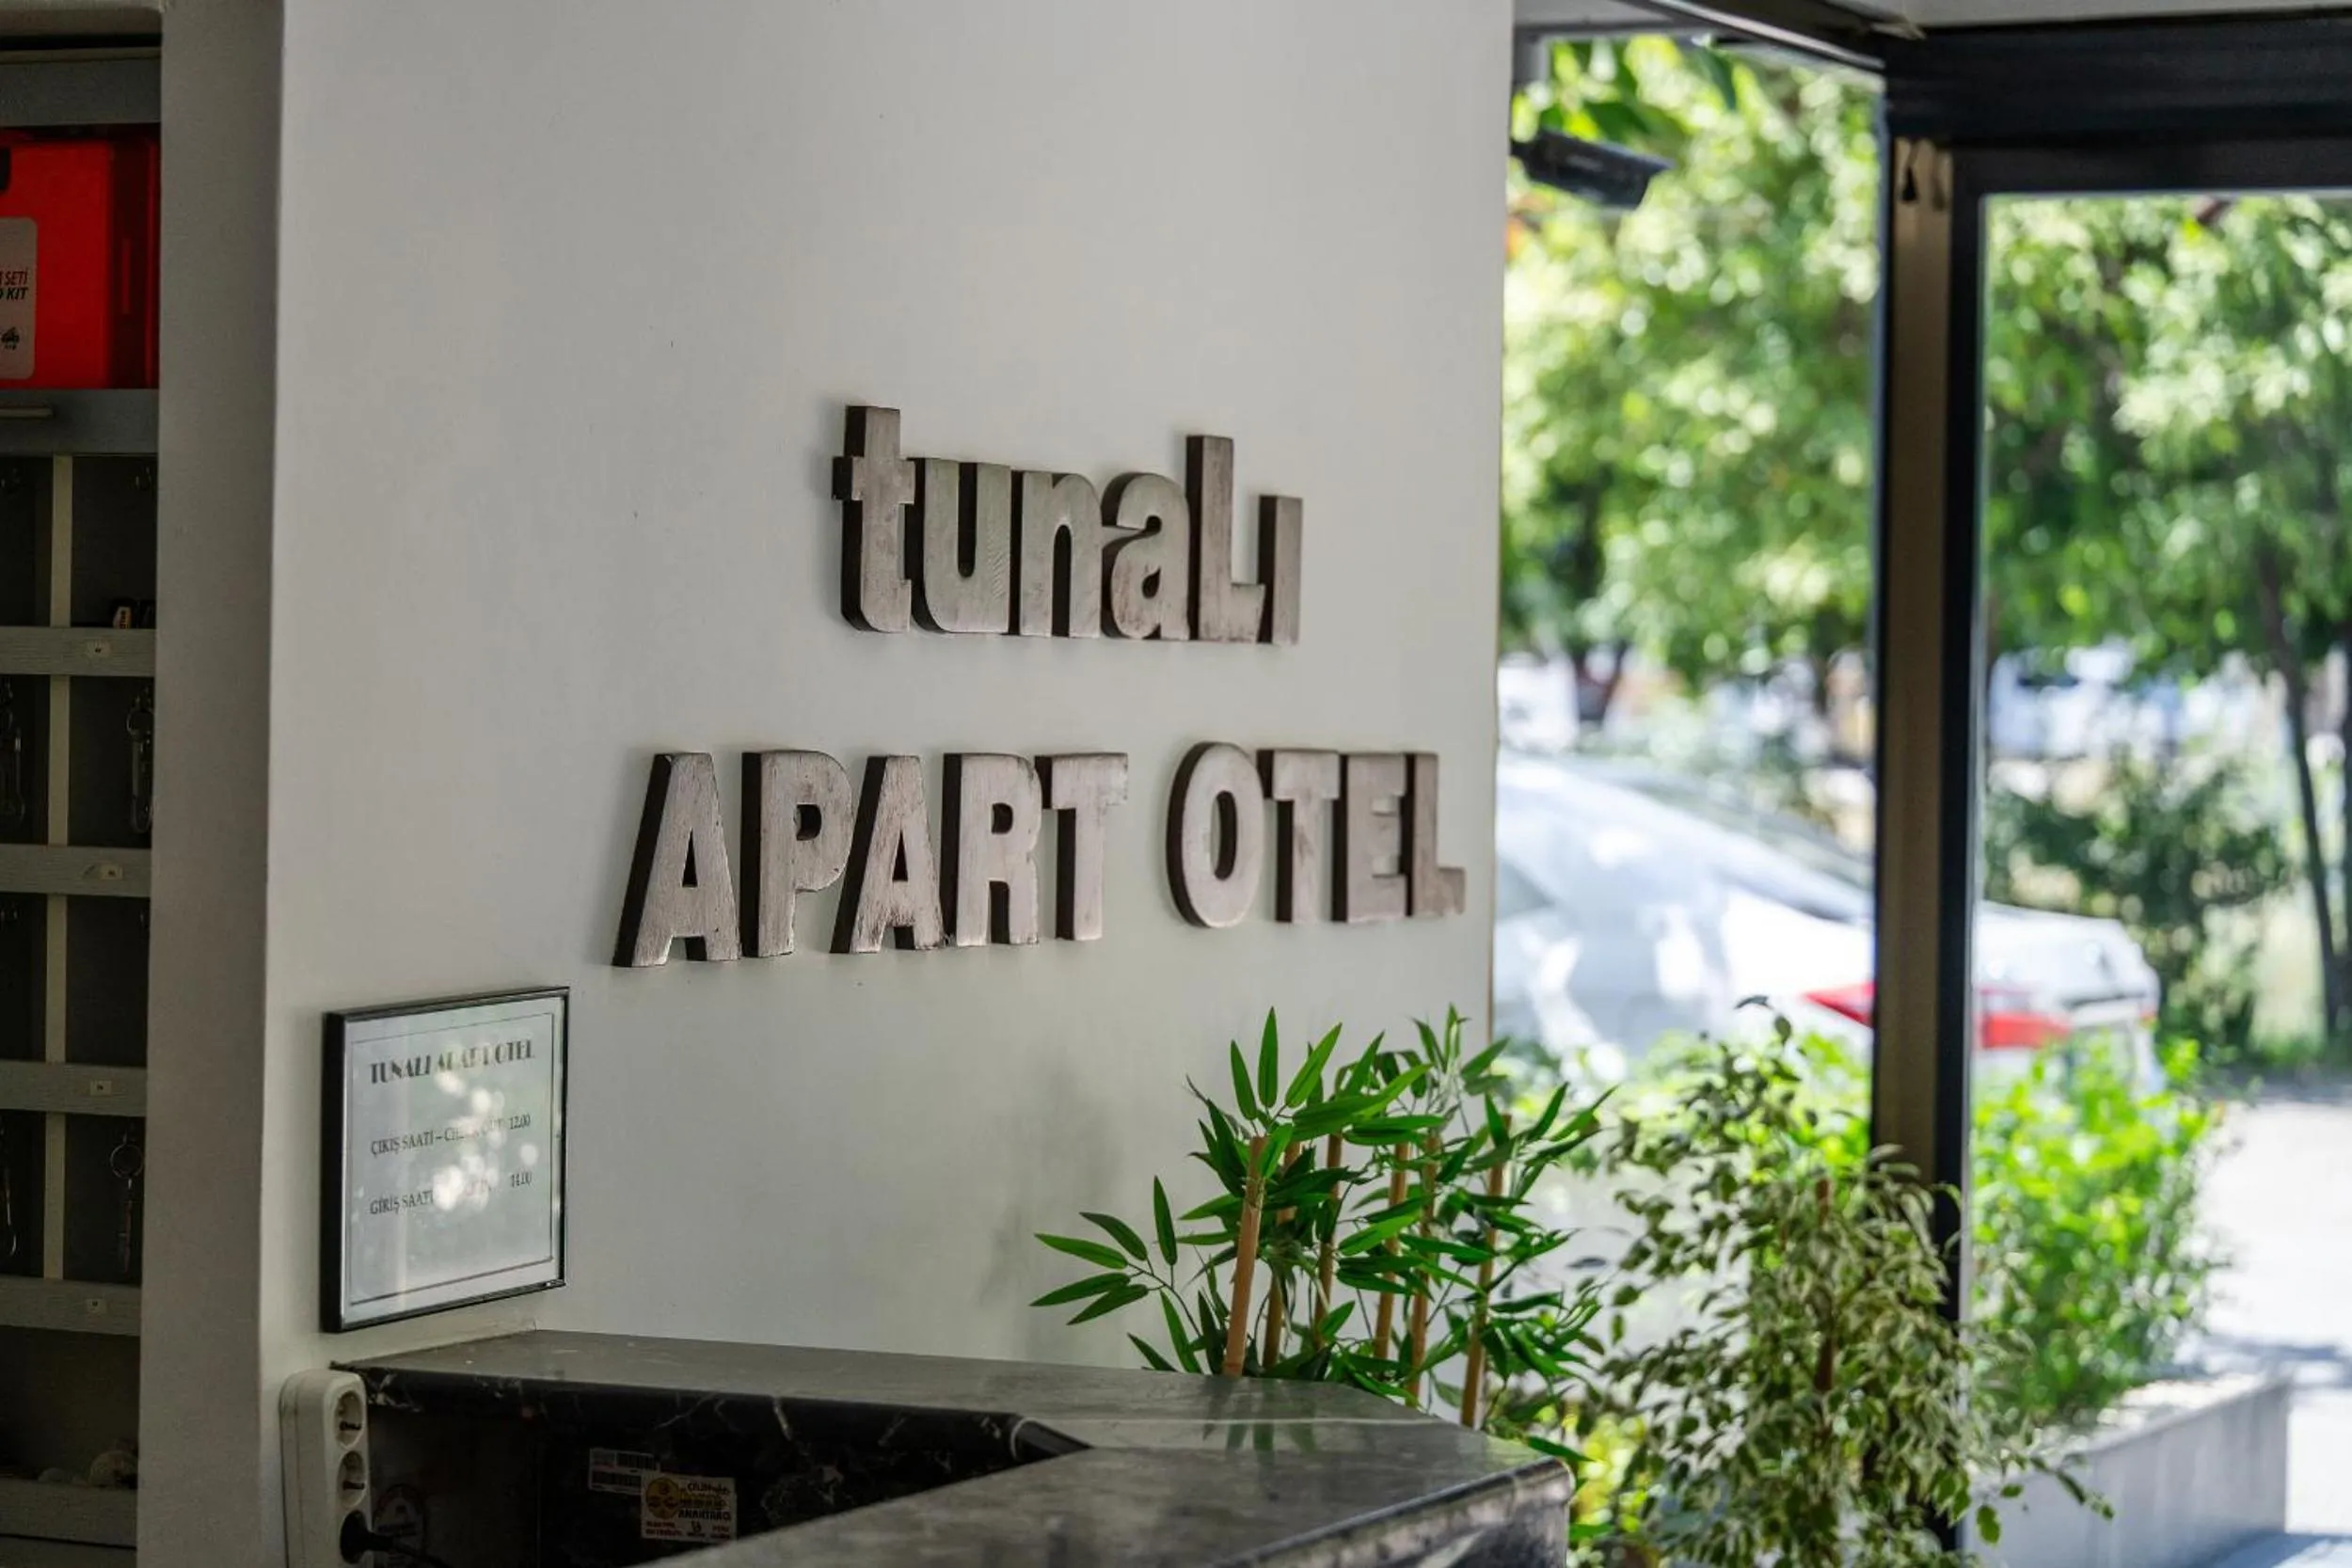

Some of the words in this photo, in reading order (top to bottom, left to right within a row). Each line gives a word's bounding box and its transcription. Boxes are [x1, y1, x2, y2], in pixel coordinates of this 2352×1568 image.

[7, 287, 28, 300] KIT
[612, 750, 1129, 969] APART
[1166, 741, 1467, 928] OTEL
[370, 1054, 432, 1084] TUNALI
